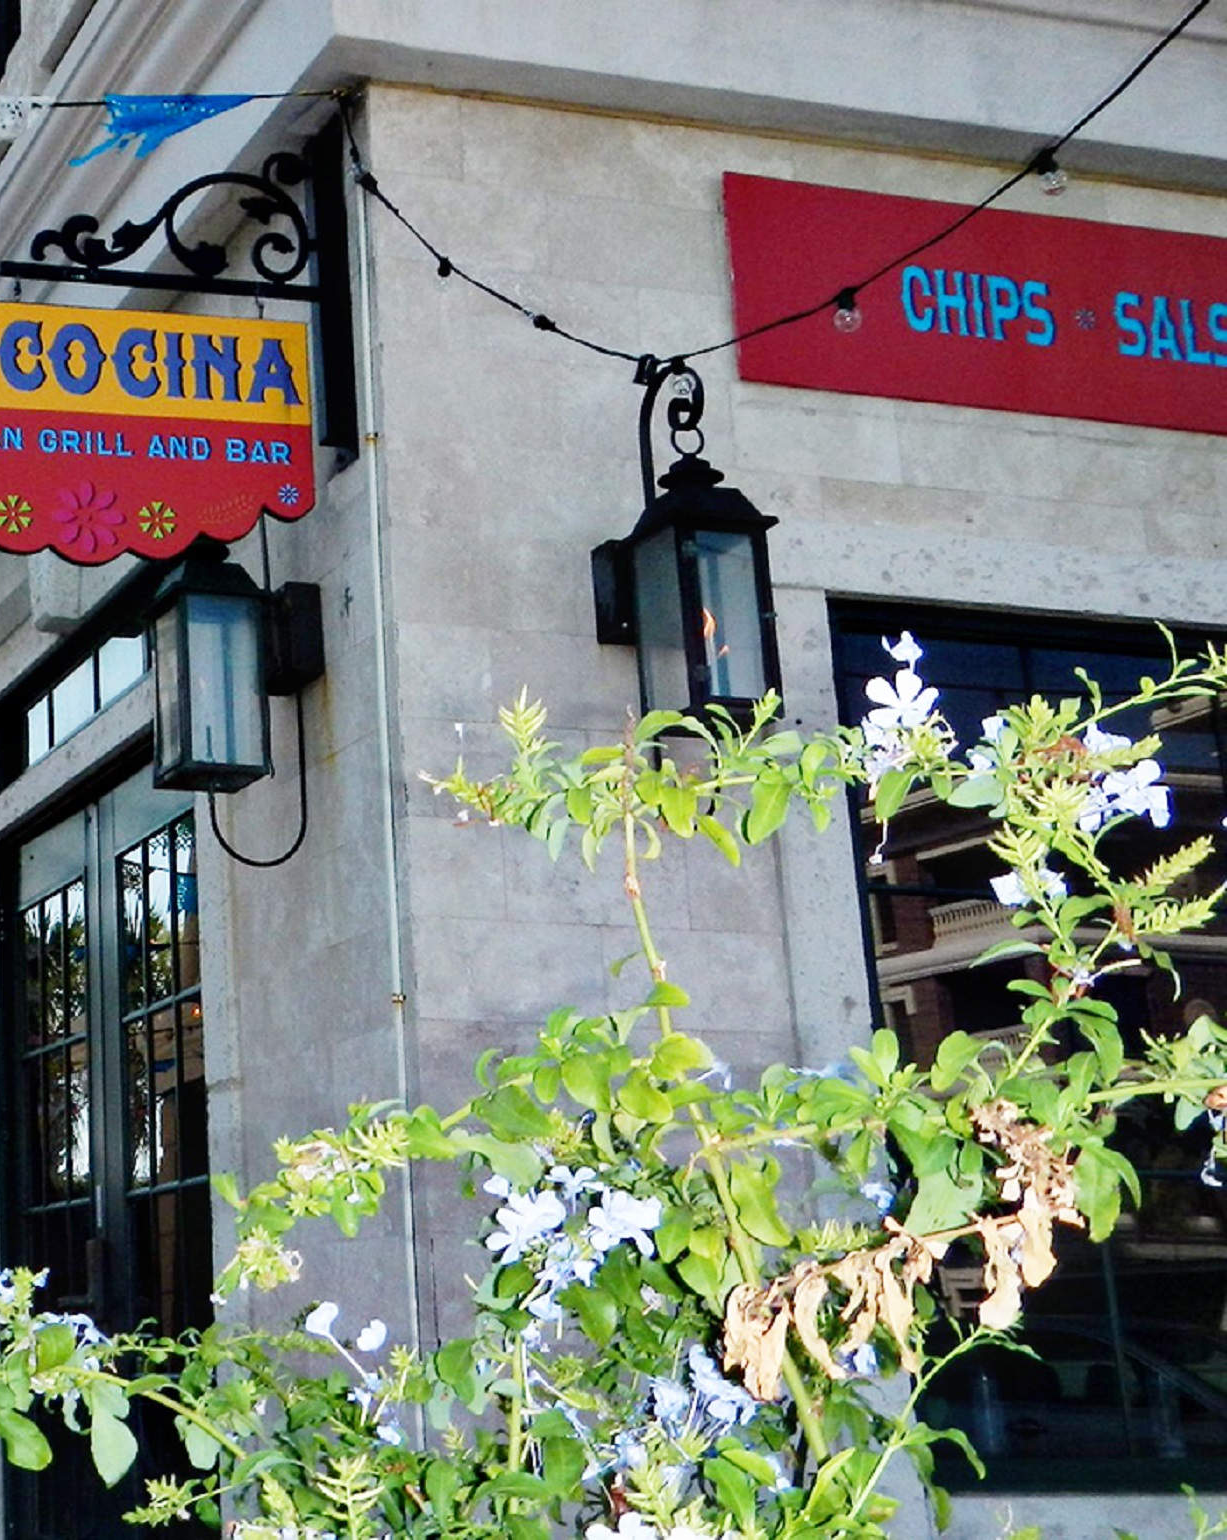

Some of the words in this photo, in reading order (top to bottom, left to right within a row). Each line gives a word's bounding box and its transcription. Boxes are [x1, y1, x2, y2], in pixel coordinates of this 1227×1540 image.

[901, 265, 1057, 347] CHIPS
[38, 429, 134, 459] GRILL
[147, 434, 212, 462] AND
[225, 438, 291, 466] BAR
